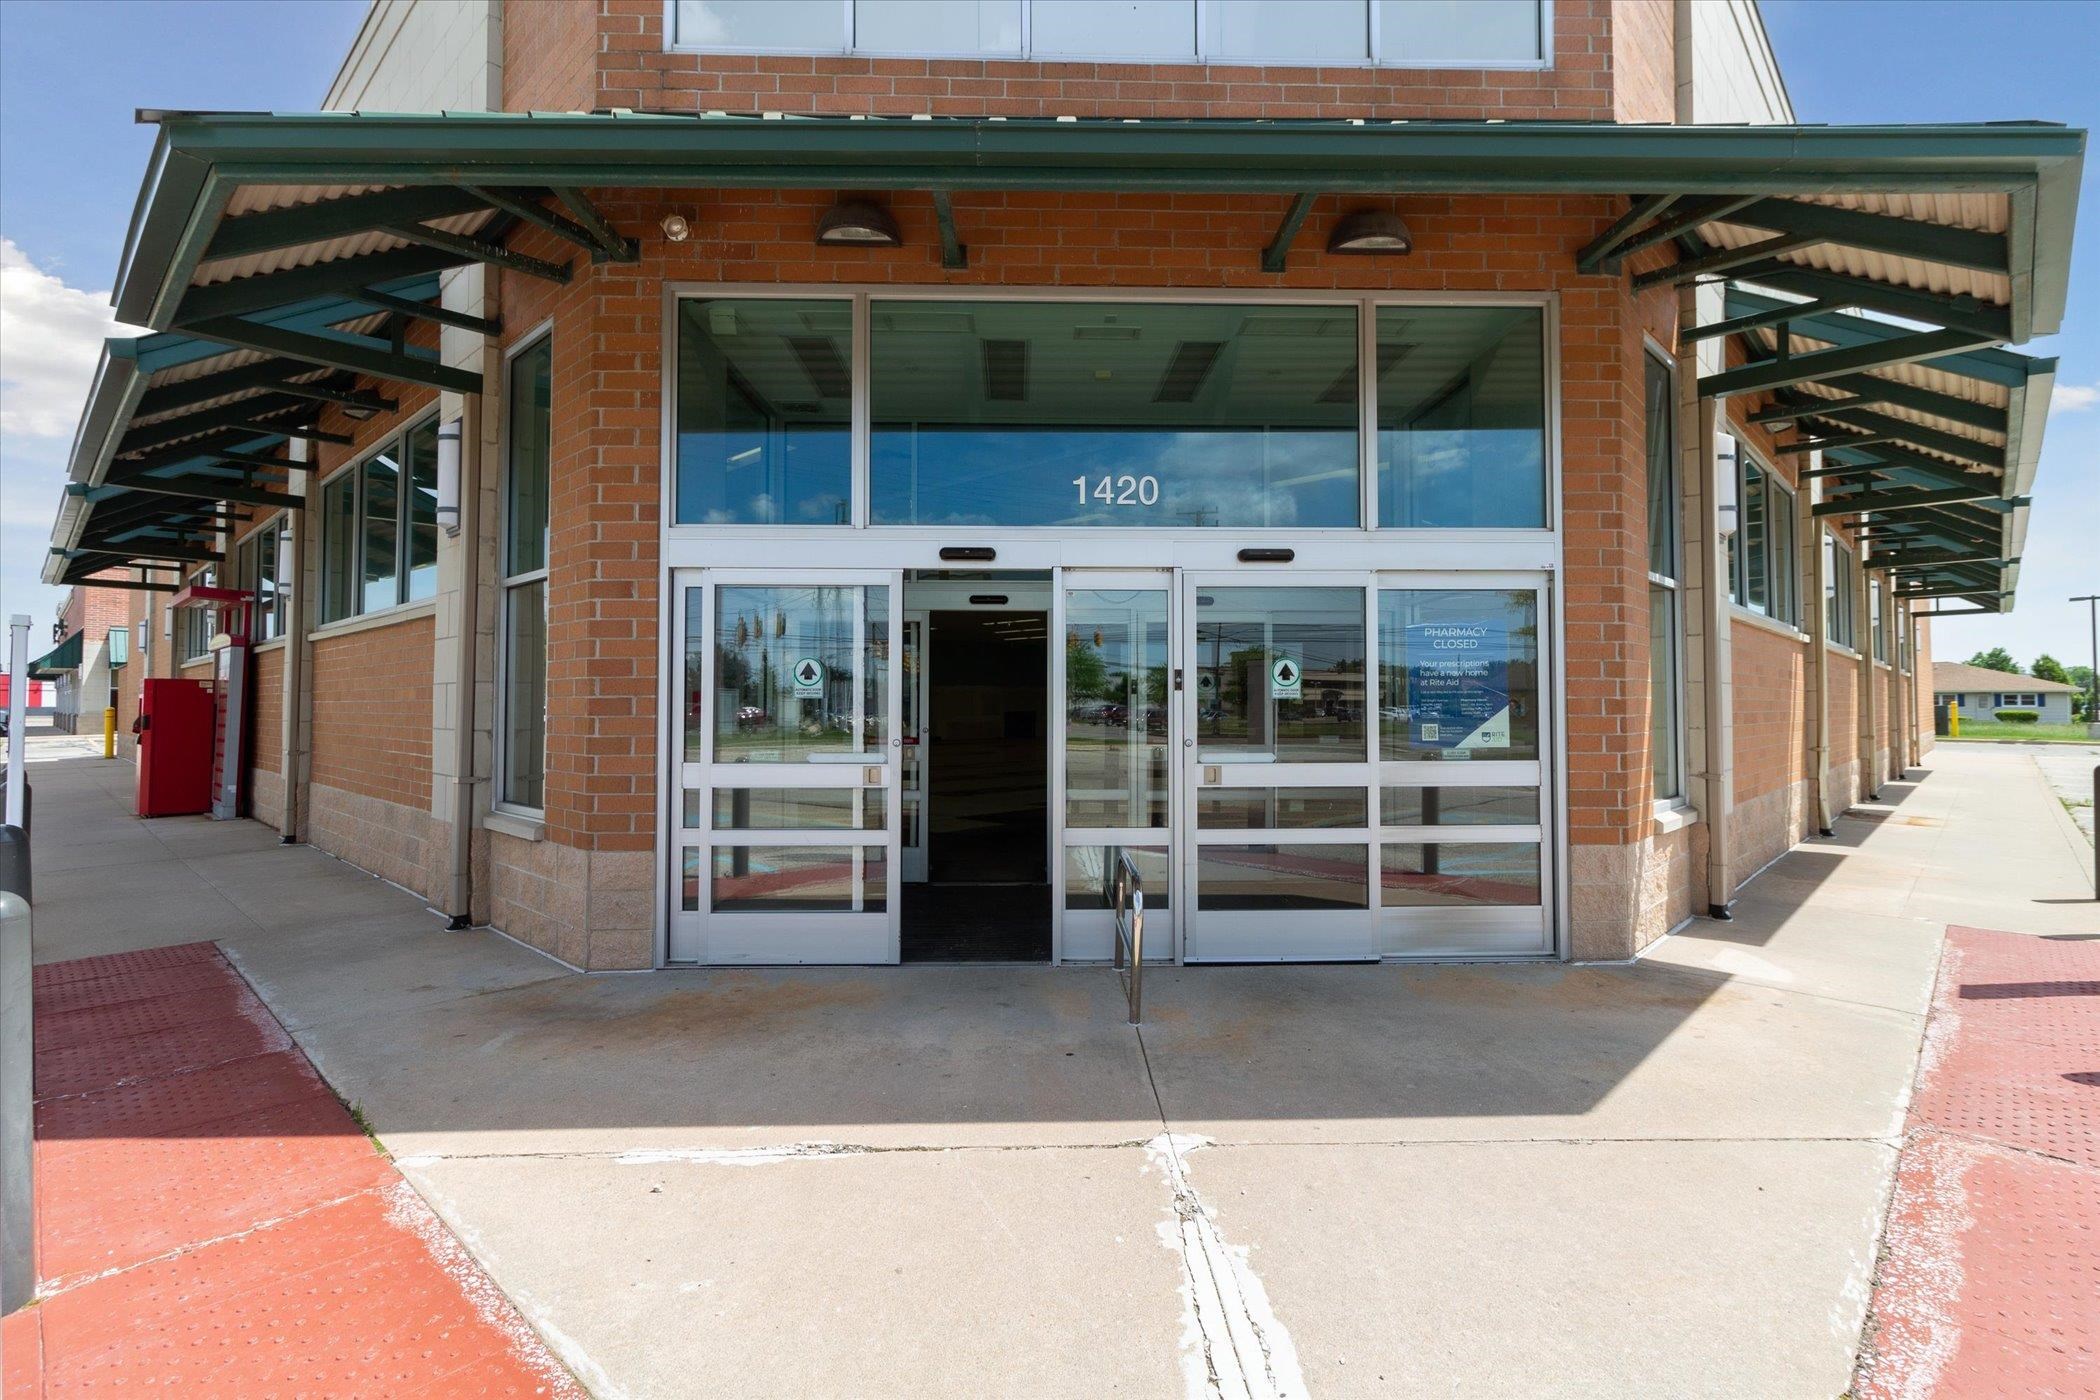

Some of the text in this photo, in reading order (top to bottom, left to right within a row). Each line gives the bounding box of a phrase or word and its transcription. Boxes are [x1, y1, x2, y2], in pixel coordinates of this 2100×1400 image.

[1073, 475, 1159, 506] 1420
[1424, 627, 1488, 637] PHARMACY
[1433, 639, 1478, 649] CLOSED
[1419, 660, 1490, 669] Your prescriptions
[1420, 669, 1439, 677] have
[1465, 669, 1489, 677] home
[1429, 678, 1445, 686] Rite
[1446, 678, 1460, 686] Aid
